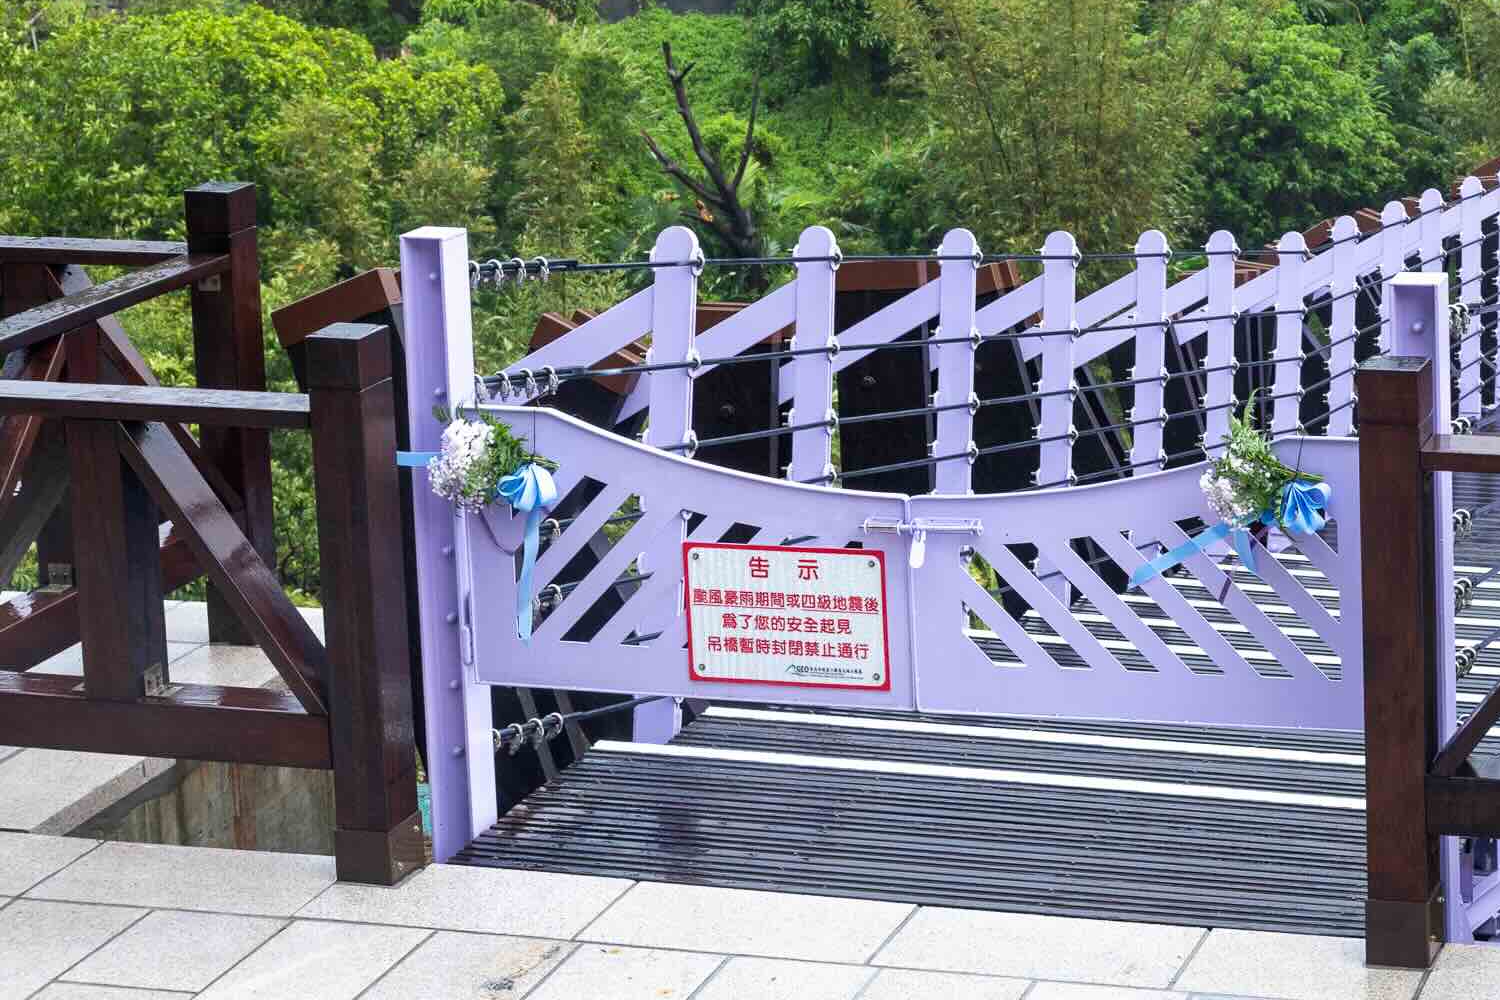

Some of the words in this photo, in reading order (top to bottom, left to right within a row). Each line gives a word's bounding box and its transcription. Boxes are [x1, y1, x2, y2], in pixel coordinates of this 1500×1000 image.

[748, 557, 819, 580] 告示
[707, 636, 870, 660] 吊橋暫時封閉禁止通行
